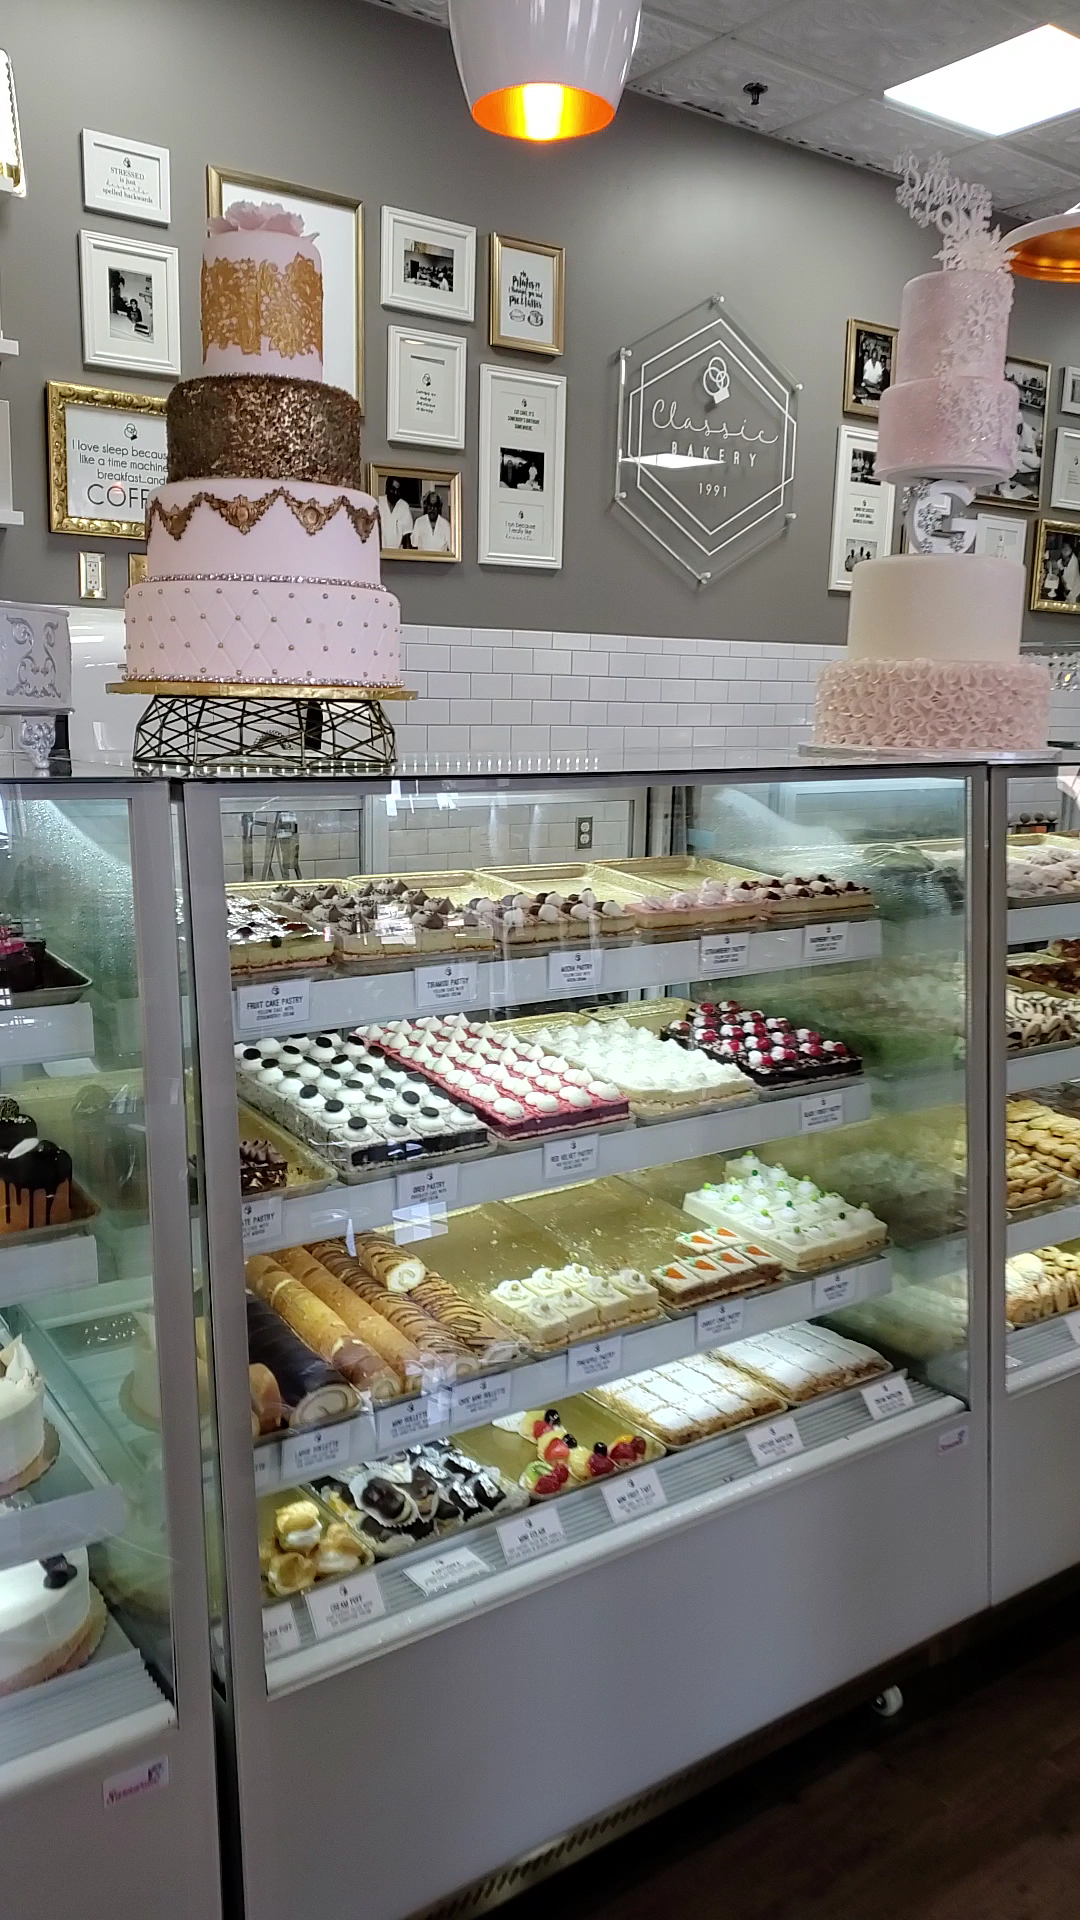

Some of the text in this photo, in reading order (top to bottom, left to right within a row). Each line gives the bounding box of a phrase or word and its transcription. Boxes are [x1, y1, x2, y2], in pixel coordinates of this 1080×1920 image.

[110, 166, 145, 180] STRESSED
[119, 175, 125, 183] is
[102, 187, 153, 204] spelled backwards
[652, 399, 779, 444] Classic
[72, 438, 168, 460] I love sleep becaus
[671, 441, 757, 467] BAKERY
[79, 452, 168, 473] like a time machine
[87, 483, 150, 510] COFF
[699, 482, 727, 498] 1991
[576, 963, 593, 971] PASTRY
[426, 976, 469, 989] TIRAMISU PASTRY
[246, 996, 303, 1010] FRUIT CAKE PASTRY
[561, 1151, 577, 1161] VELVET
[577, 1148, 594, 1157] PASTRY
[412, 1180, 446, 1193] OREO PASTRY
[252, 1212, 275, 1224] PASTRY
[616, 1494, 627, 1504] MINI
[626, 1489, 639, 1499] FRUIT
[518, 1533, 529, 1543] MINI
[330, 1593, 363, 1612] CREAM PUFF
